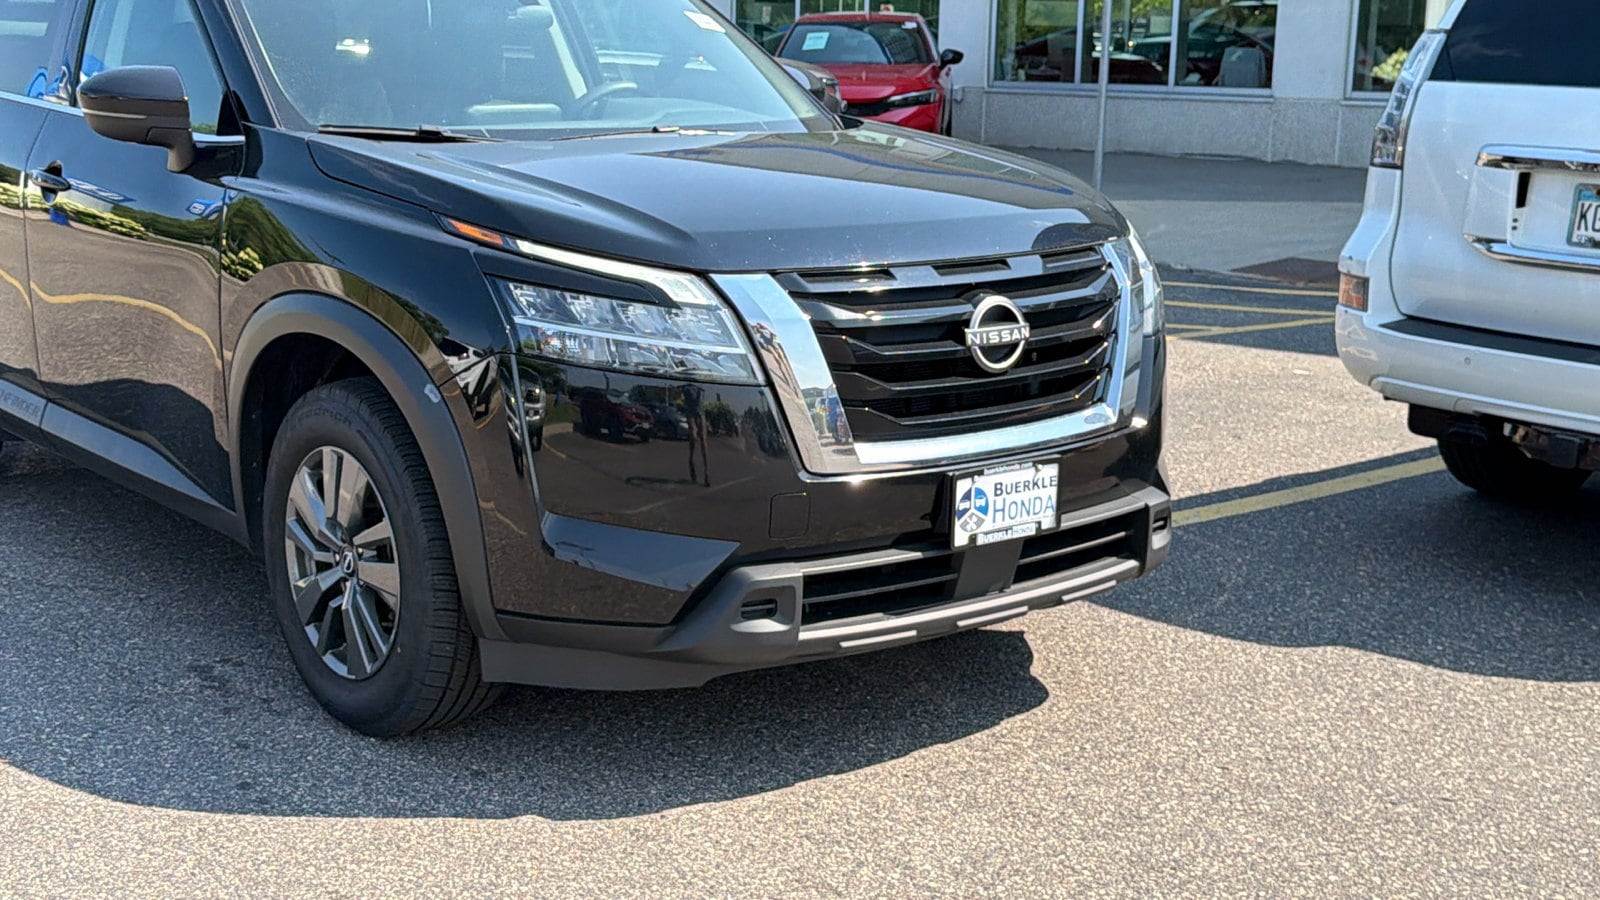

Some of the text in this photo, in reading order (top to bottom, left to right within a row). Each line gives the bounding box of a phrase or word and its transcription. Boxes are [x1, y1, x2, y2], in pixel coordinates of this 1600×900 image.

[967, 327, 1030, 345] NISSAN
[993, 475, 1057, 497] BUERKLE
[992, 494, 1056, 524] HONDA
